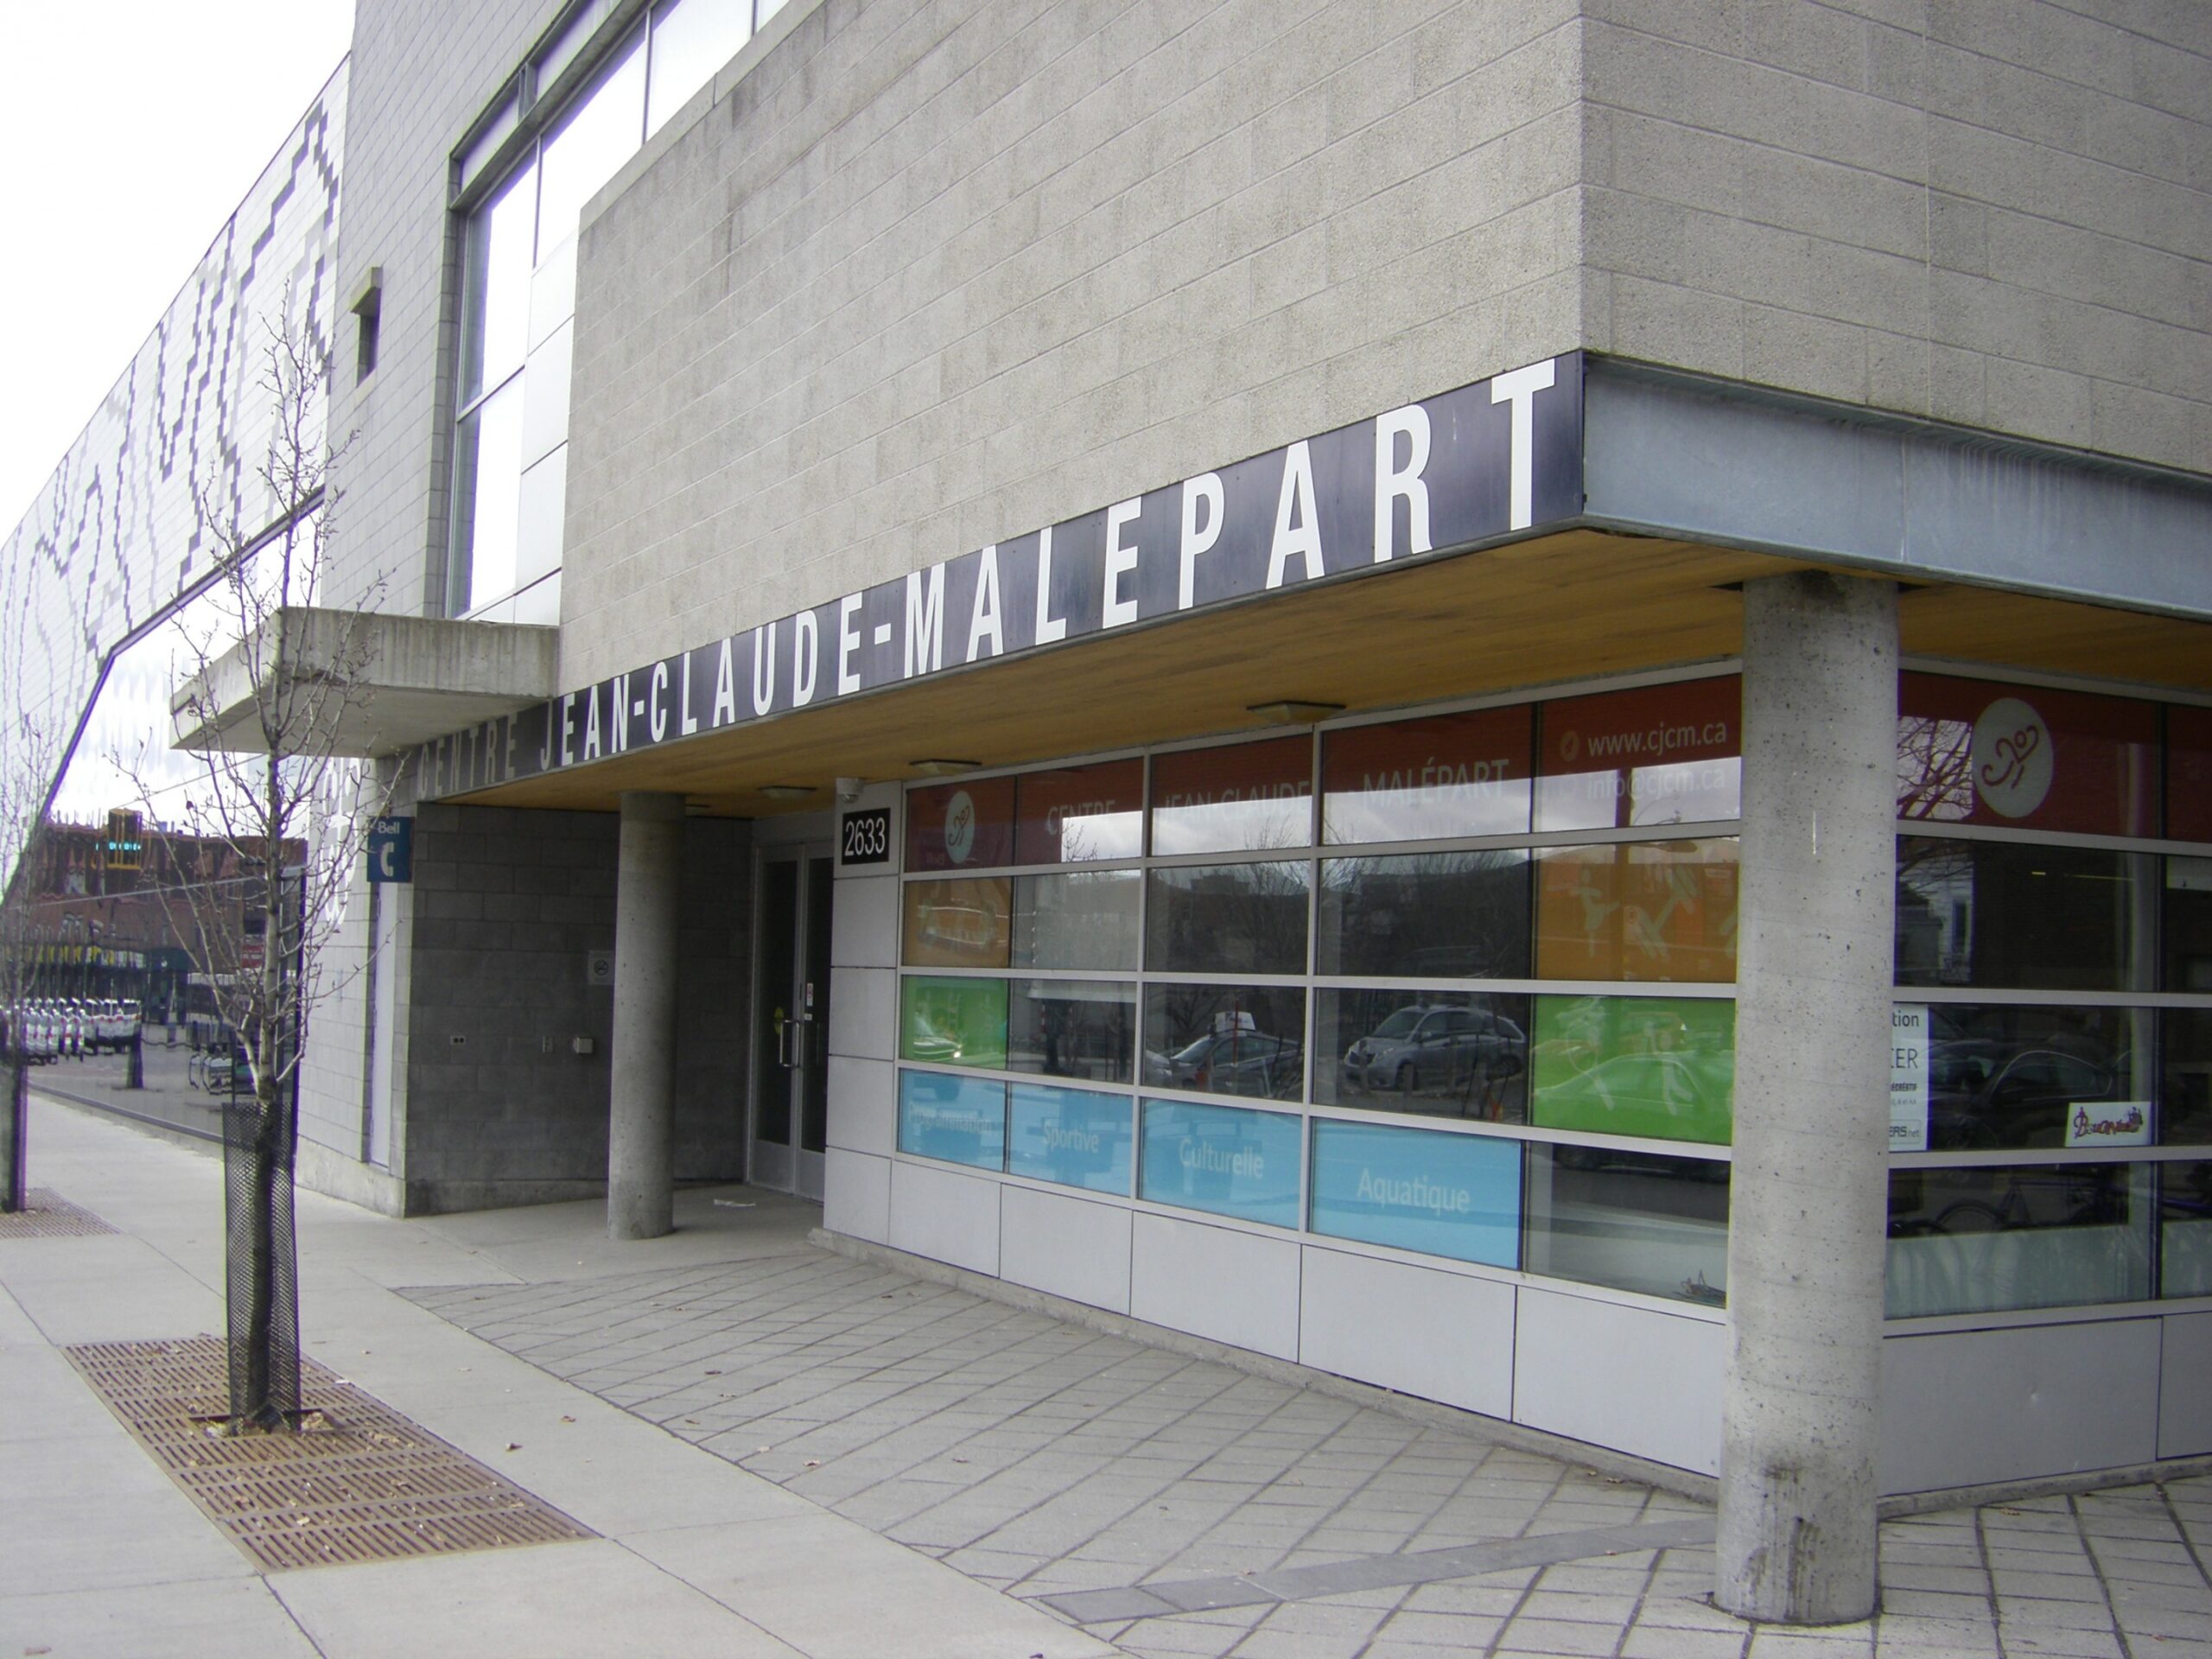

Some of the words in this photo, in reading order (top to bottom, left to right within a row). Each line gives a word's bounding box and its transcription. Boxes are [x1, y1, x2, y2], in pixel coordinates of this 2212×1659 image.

[418, 712, 518, 799] CENTRE
[540, 359, 1555, 770] JEAN-CLAUDE-MALEPART
[1588, 721, 1726, 757] www.cjcm.ca
[1363, 757, 1510, 809] MALÉPART
[378, 821, 400, 834] Bell
[844, 817, 886, 856] 2633
[1891, 1048, 1918, 1069] ER
[1043, 1122, 1099, 1153] Sportive
[1179, 1135, 1264, 1179] Culturelle
[1357, 1167, 1471, 1216] Aquatique
